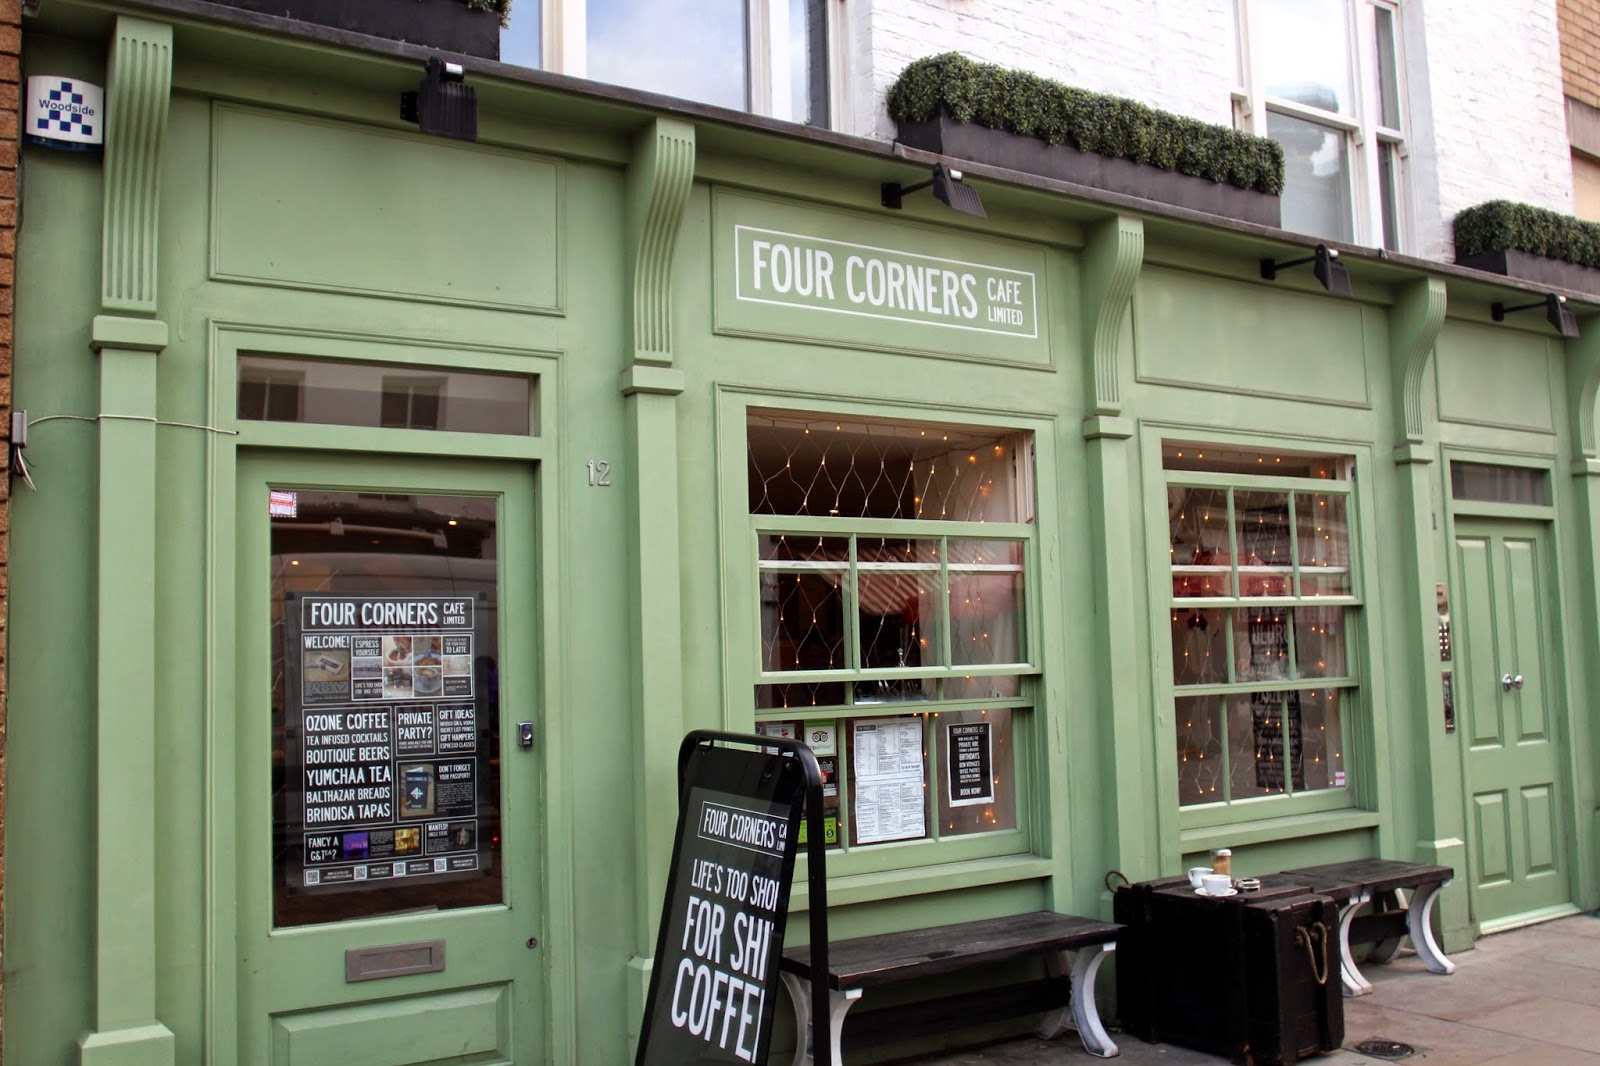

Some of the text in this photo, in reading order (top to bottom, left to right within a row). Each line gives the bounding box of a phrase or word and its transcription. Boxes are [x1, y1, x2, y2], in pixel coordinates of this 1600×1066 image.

[39, 98, 95, 117] Woodside
[752, 240, 979, 319] FOUR CORNERS
[986, 276, 1023, 305] CAFE
[987, 305, 1024, 326] LIMITED
[586, 459, 611, 487] 12
[311, 602, 438, 626] FOUR CORNERS
[443, 602, 465, 615] CAFE
[443, 616, 465, 625] LIMITED
[304, 635, 350, 649] WELCOME!
[355, 640, 379, 648] ESPRESS
[306, 712, 388, 731] OZONE COFFEE
[398, 712, 432, 725] PRIVATE
[439, 709, 474, 720] GIFT IDEAS
[306, 732, 388, 746] TEA INFUSED COCKTAILS
[398, 726, 433, 740] PARTY?
[440, 733, 474, 742] GIFT HAMPERS
[306, 746, 390, 764] BOUTIQUE BEERS
[306, 765, 391, 786] YUMCHAA TEA
[438, 764, 471, 773] DON'T FORGET
[306, 786, 390, 804] BALTHAZAR BREADS
[306, 803, 391, 823] BRINDISA TAPAS
[703, 808, 728, 837] FOUR
[729, 813, 776, 849] CORNERS
[308, 835, 339, 848] FANCY A
[691, 858, 724, 895] LIFE'S
[725, 867, 748, 902] TOO
[681, 895, 774, 981] FOR SHI
[671, 957, 766, 1065] COFFE
